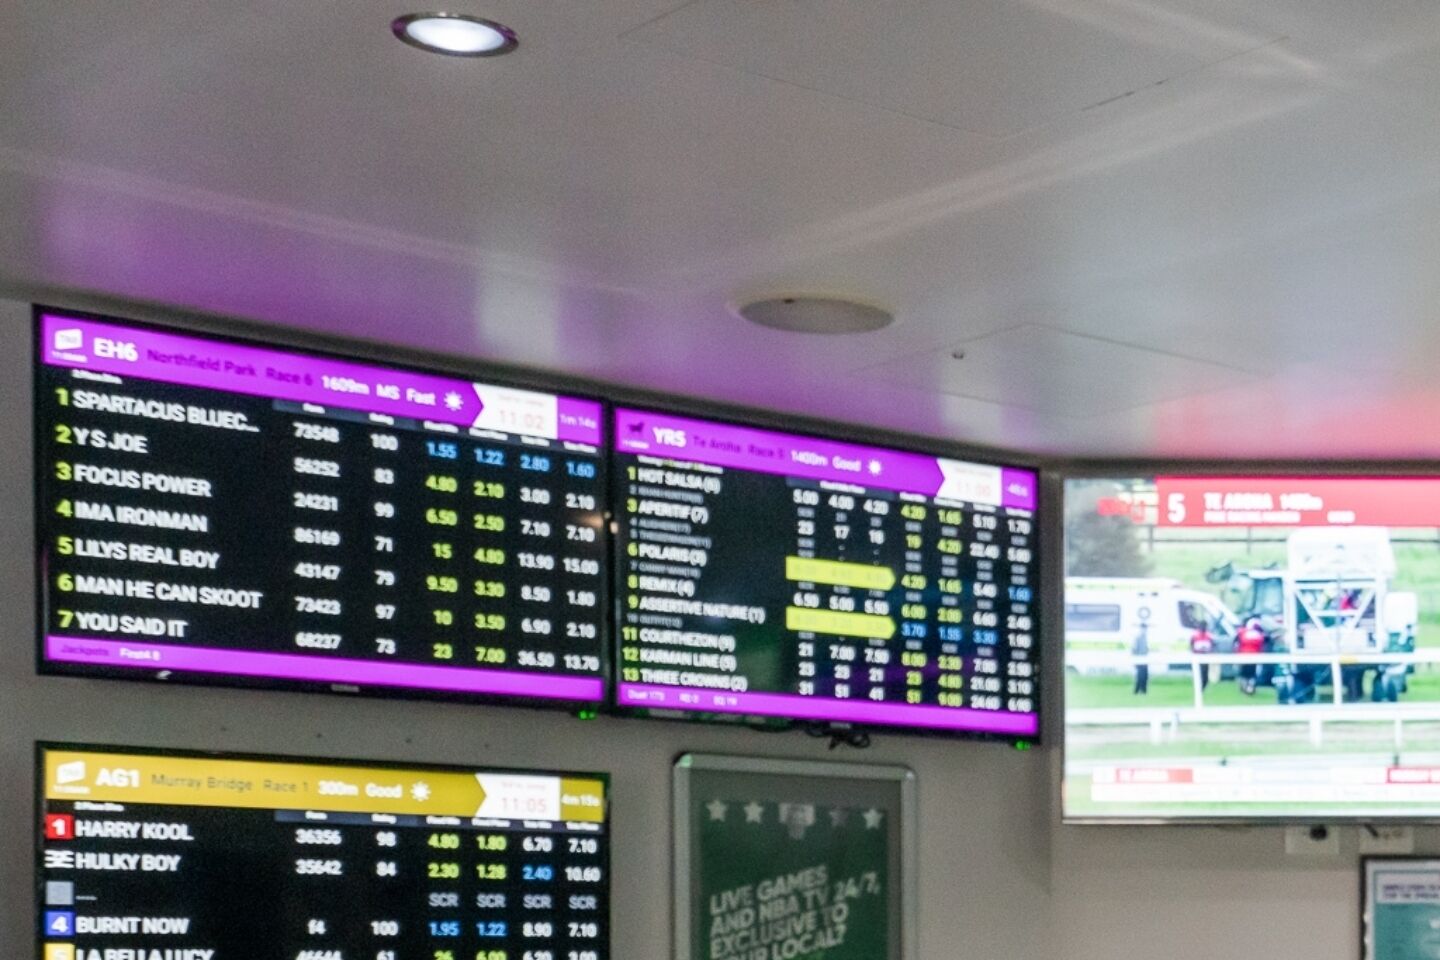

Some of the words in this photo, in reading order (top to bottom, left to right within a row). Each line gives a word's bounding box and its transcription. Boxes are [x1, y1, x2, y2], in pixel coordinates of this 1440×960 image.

[94, 337, 138, 361] EH6
[147, 350, 220, 372] Northfield
[224, 360, 256, 377] Park
[266, 367, 299, 383] Race
[376, 384, 400, 400] MS
[406, 387, 436, 406] Fast
[55, 388, 69, 406] 1
[73, 389, 185, 423] SPARTACUS
[55, 425, 72, 444] 2
[73, 426, 90, 446] Y
[91, 429, 107, 448] S
[108, 432, 148, 454] JOE
[56, 462, 72, 481] 3
[74, 464, 141, 491] FOCUS
[142, 471, 213, 498] POWER
[56, 500, 72, 518] 4
[74, 501, 116, 524] IMA
[116, 506, 208, 532] IRONMAN
[57, 537, 73, 555] 5
[75, 538, 127, 561] LILYS
[130, 543, 179, 566] REAL
[180, 550, 220, 569] BOY
[57, 574, 73, 592] 6
[75, 575, 125, 596] MAN
[126, 579, 154, 599] HE
[156, 583, 197, 603] CAN
[199, 586, 263, 609] SKOOT
[57, 610, 74, 628] 7
[75, 611, 119, 633] YOU
[120, 616, 166, 636] SAID
[167, 620, 189, 637] IT
[96, 768, 140, 788] AG1
[150, 774, 201, 790] Murray
[207, 777, 252, 792] Bridge
[263, 780, 296, 793] Race
[52, 819, 66, 836] 1
[75, 820, 141, 839] HARRY
[142, 823, 194, 841] KOOL
[75, 853, 140, 870] HULKY
[142, 855, 181, 871] BOY
[429, 892, 459, 907] SCR
[477, 893, 506, 908] SCR
[523, 894, 552, 909] SCR
[568, 895, 598, 910] SCR
[710, 884, 752, 916] LIVE
[757, 865, 828, 901] GAMES
[52, 916, 68, 933] 4
[76, 917, 142, 934] BURNT
[142, 918, 190, 935] NOW
[710, 908, 754, 938] AND
[759, 895, 798, 922] NBA
[802, 885, 829, 909] TV
[710, 910, 816, 960] EXCLUSIVE
[822, 903, 849, 927] TO
